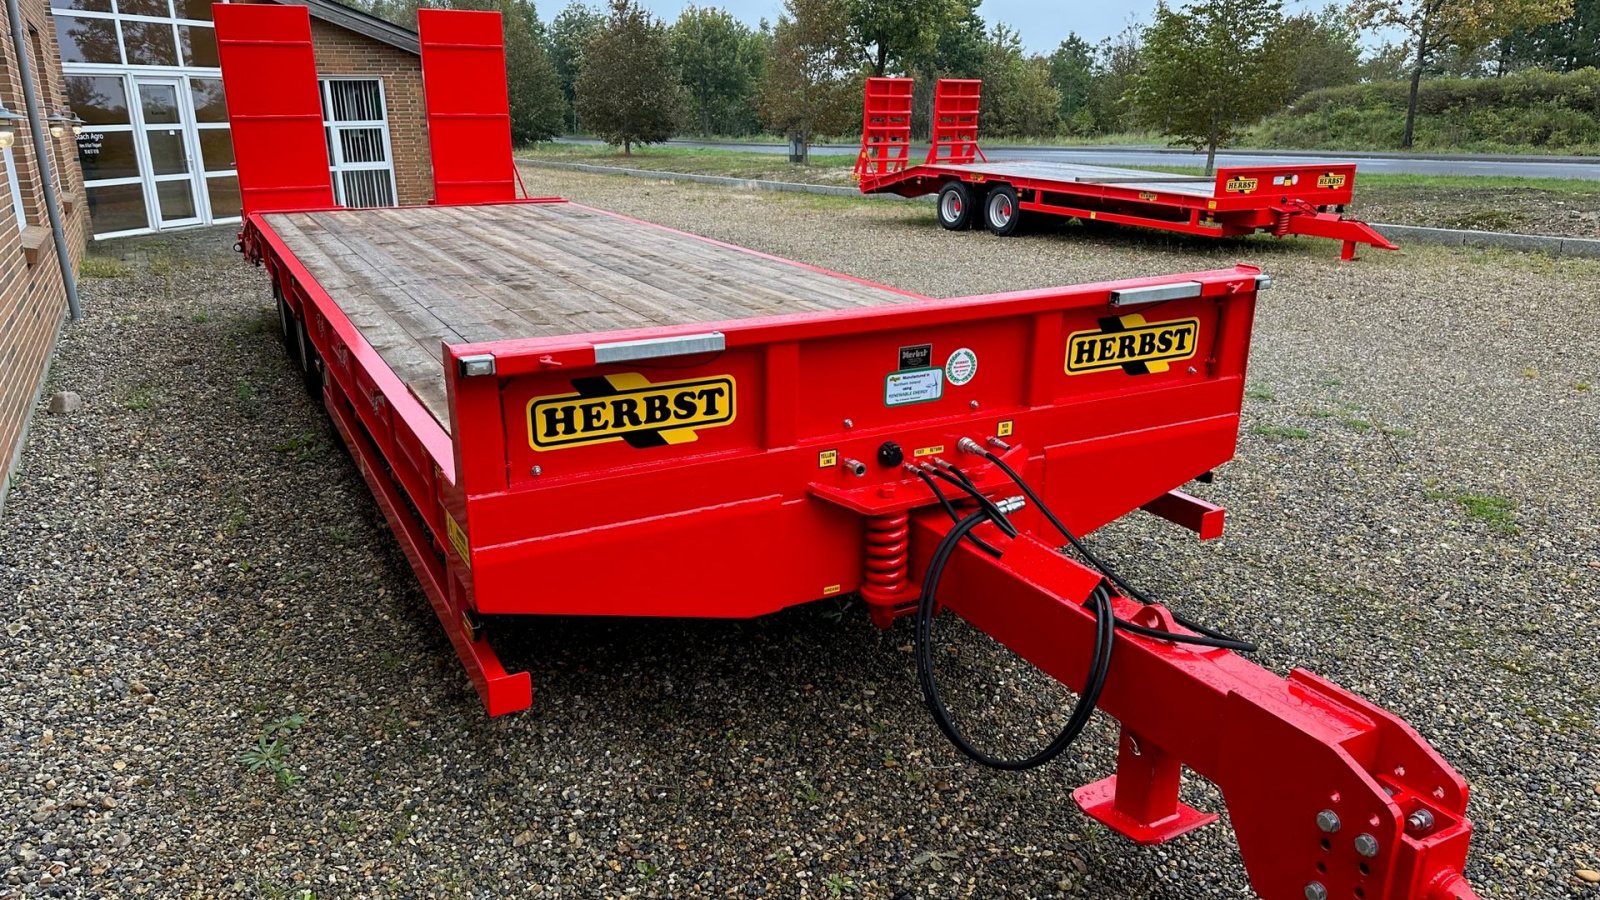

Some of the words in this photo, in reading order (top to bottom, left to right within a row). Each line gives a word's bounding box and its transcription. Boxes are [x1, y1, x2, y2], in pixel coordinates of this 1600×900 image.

[90, 133, 104, 141] Agro
[1228, 181, 1256, 189] HERBST
[1319, 177, 1344, 185] HERBST
[1073, 327, 1192, 365] HERBST
[542, 387, 725, 438] HERBST
